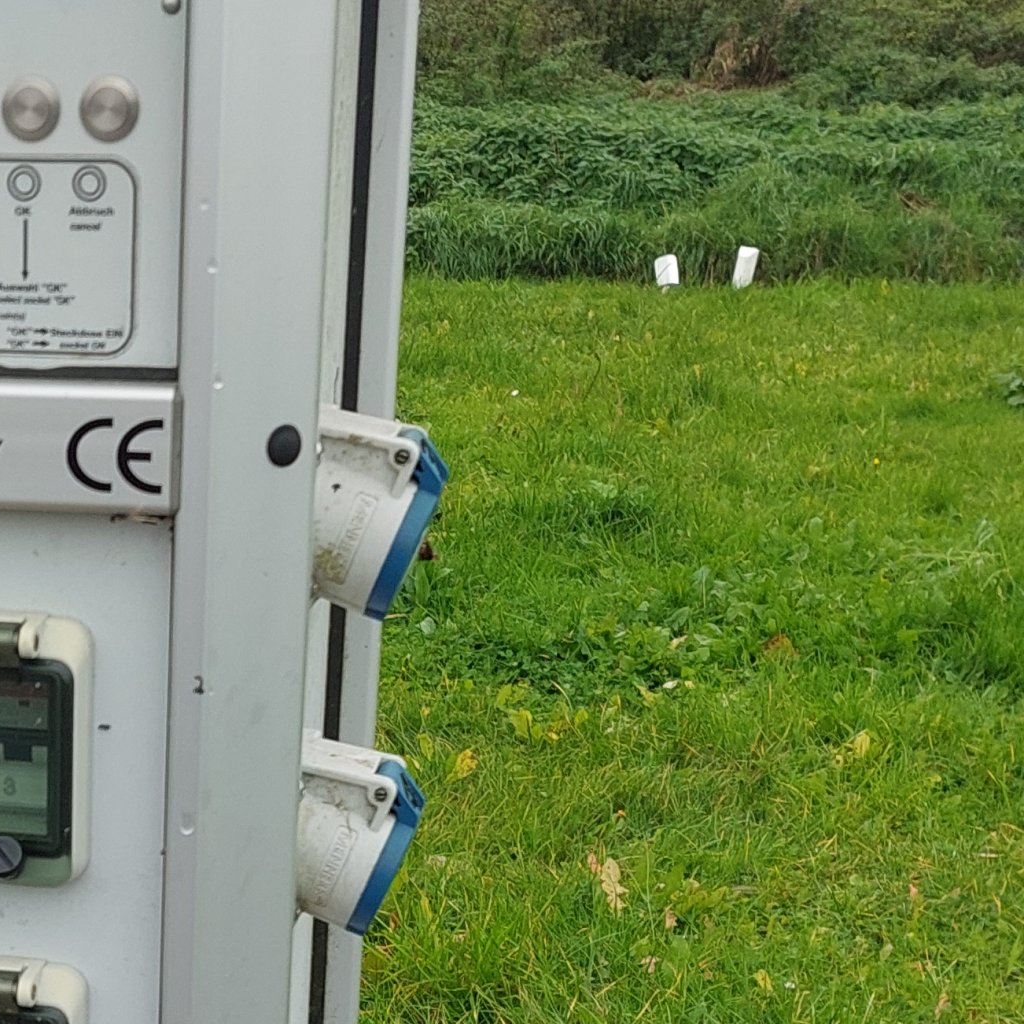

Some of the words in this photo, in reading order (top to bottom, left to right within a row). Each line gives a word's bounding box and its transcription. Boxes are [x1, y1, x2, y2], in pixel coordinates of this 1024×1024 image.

[68, 206, 115, 217] Abbruch
[66, 417, 164, 494] CE
[3, 777, 18, 796] 3
